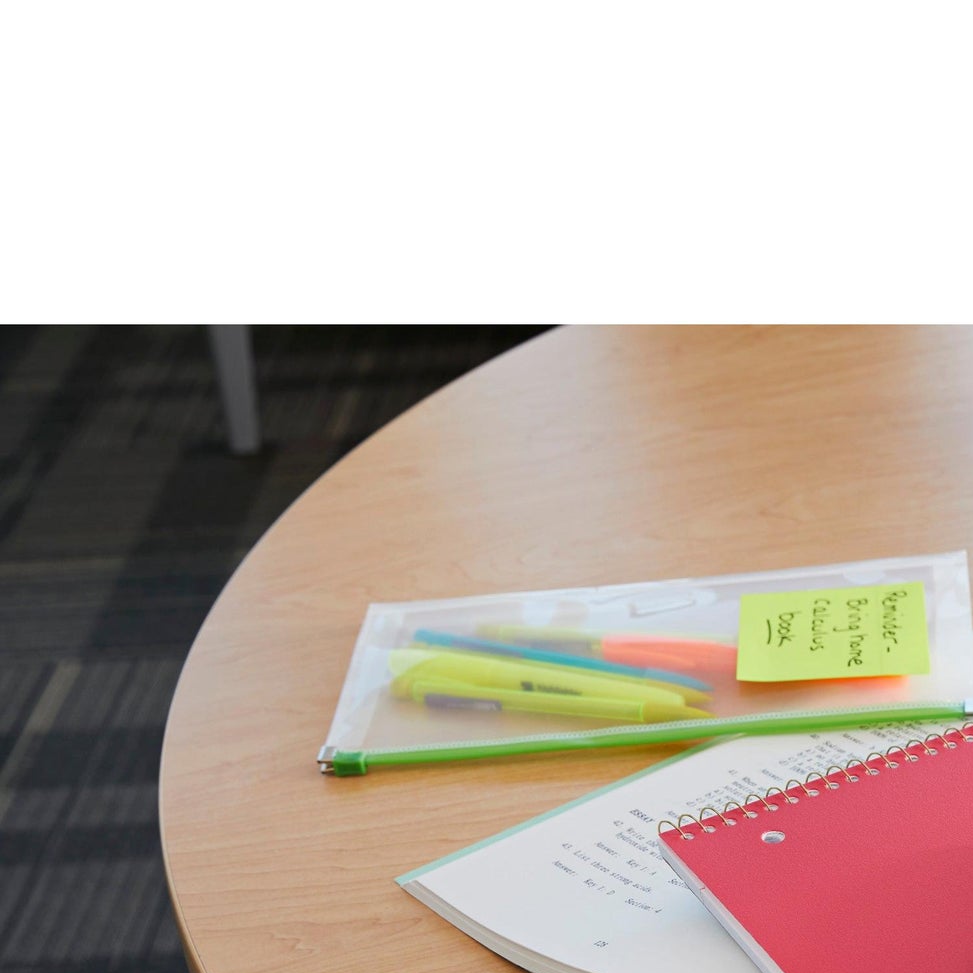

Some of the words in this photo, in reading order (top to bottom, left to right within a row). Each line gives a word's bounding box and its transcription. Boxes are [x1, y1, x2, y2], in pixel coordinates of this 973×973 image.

[777, 610, 802, 648] book
[628, 808, 656, 823] ESSAY
[590, 860, 610, 873] three
